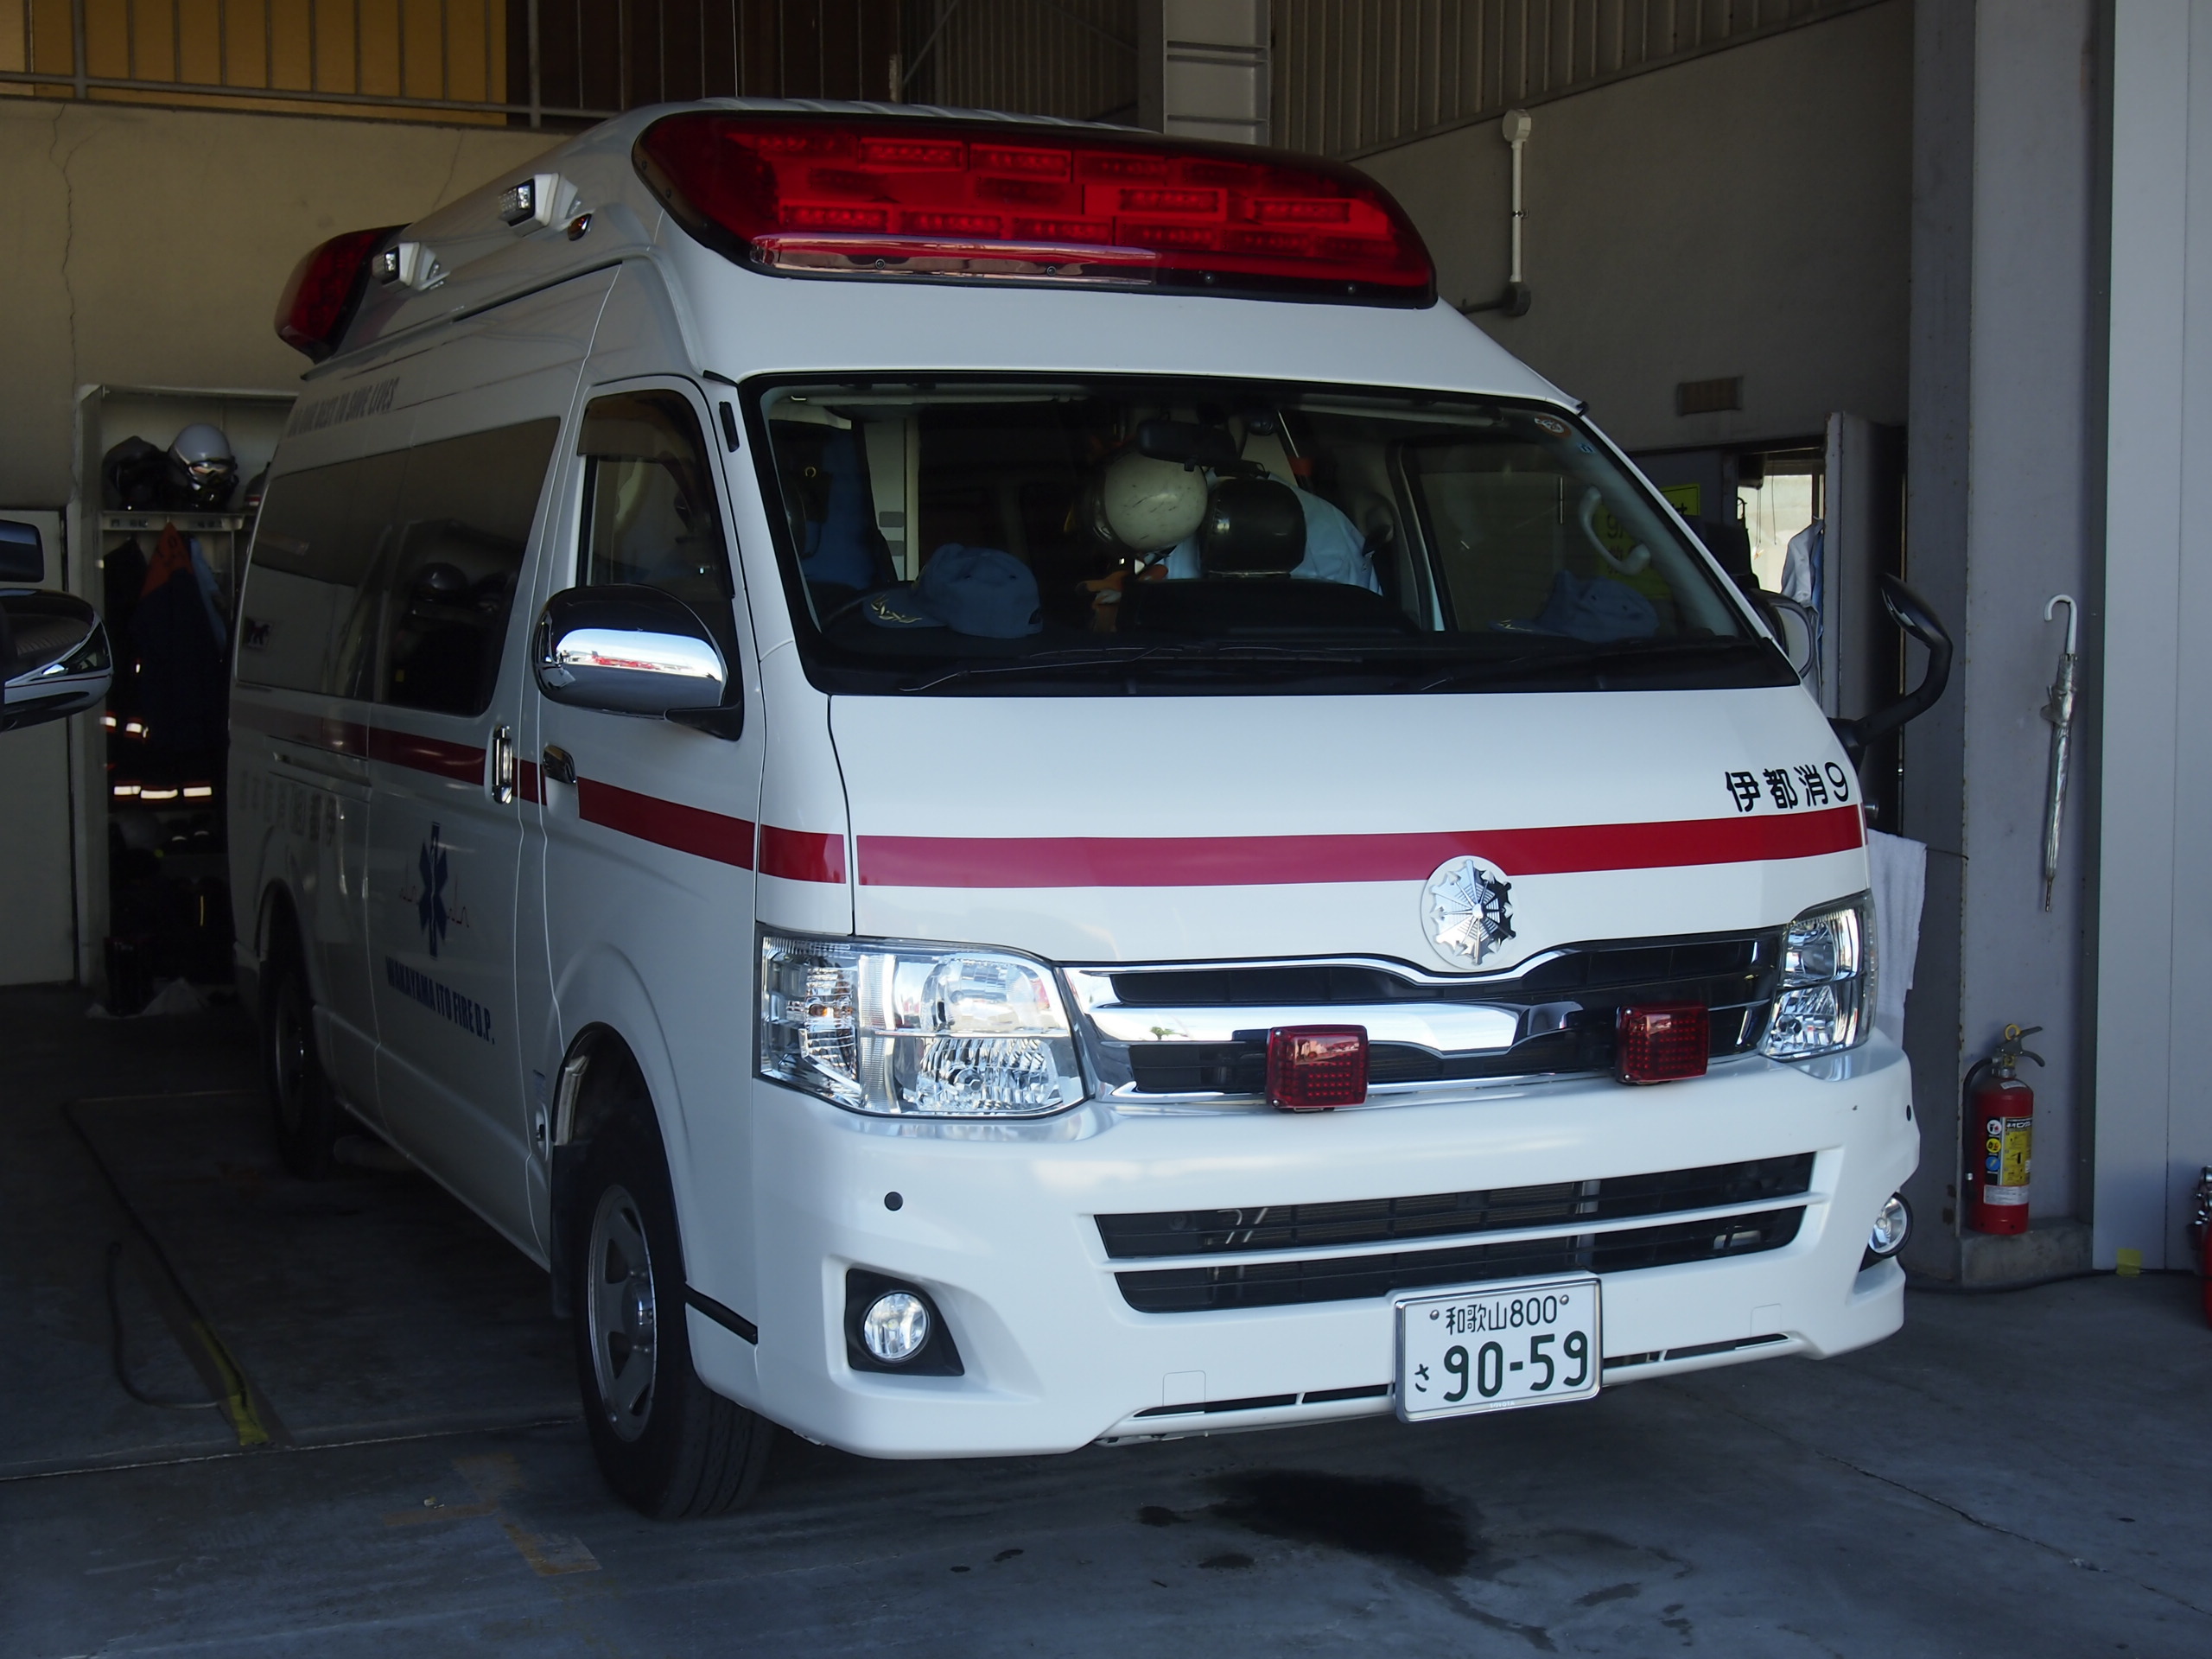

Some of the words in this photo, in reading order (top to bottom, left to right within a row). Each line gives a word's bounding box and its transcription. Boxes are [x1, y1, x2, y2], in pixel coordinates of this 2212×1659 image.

[368, 377, 400, 415] LIVES
[385, 956, 435, 1011] WAKAYAMA
[435, 982, 452, 1020] ITO
[453, 991, 474, 1033] FIRE
[1414, 1363, 1429, 1393] さ
[1443, 1331, 1588, 1402] 90-59
